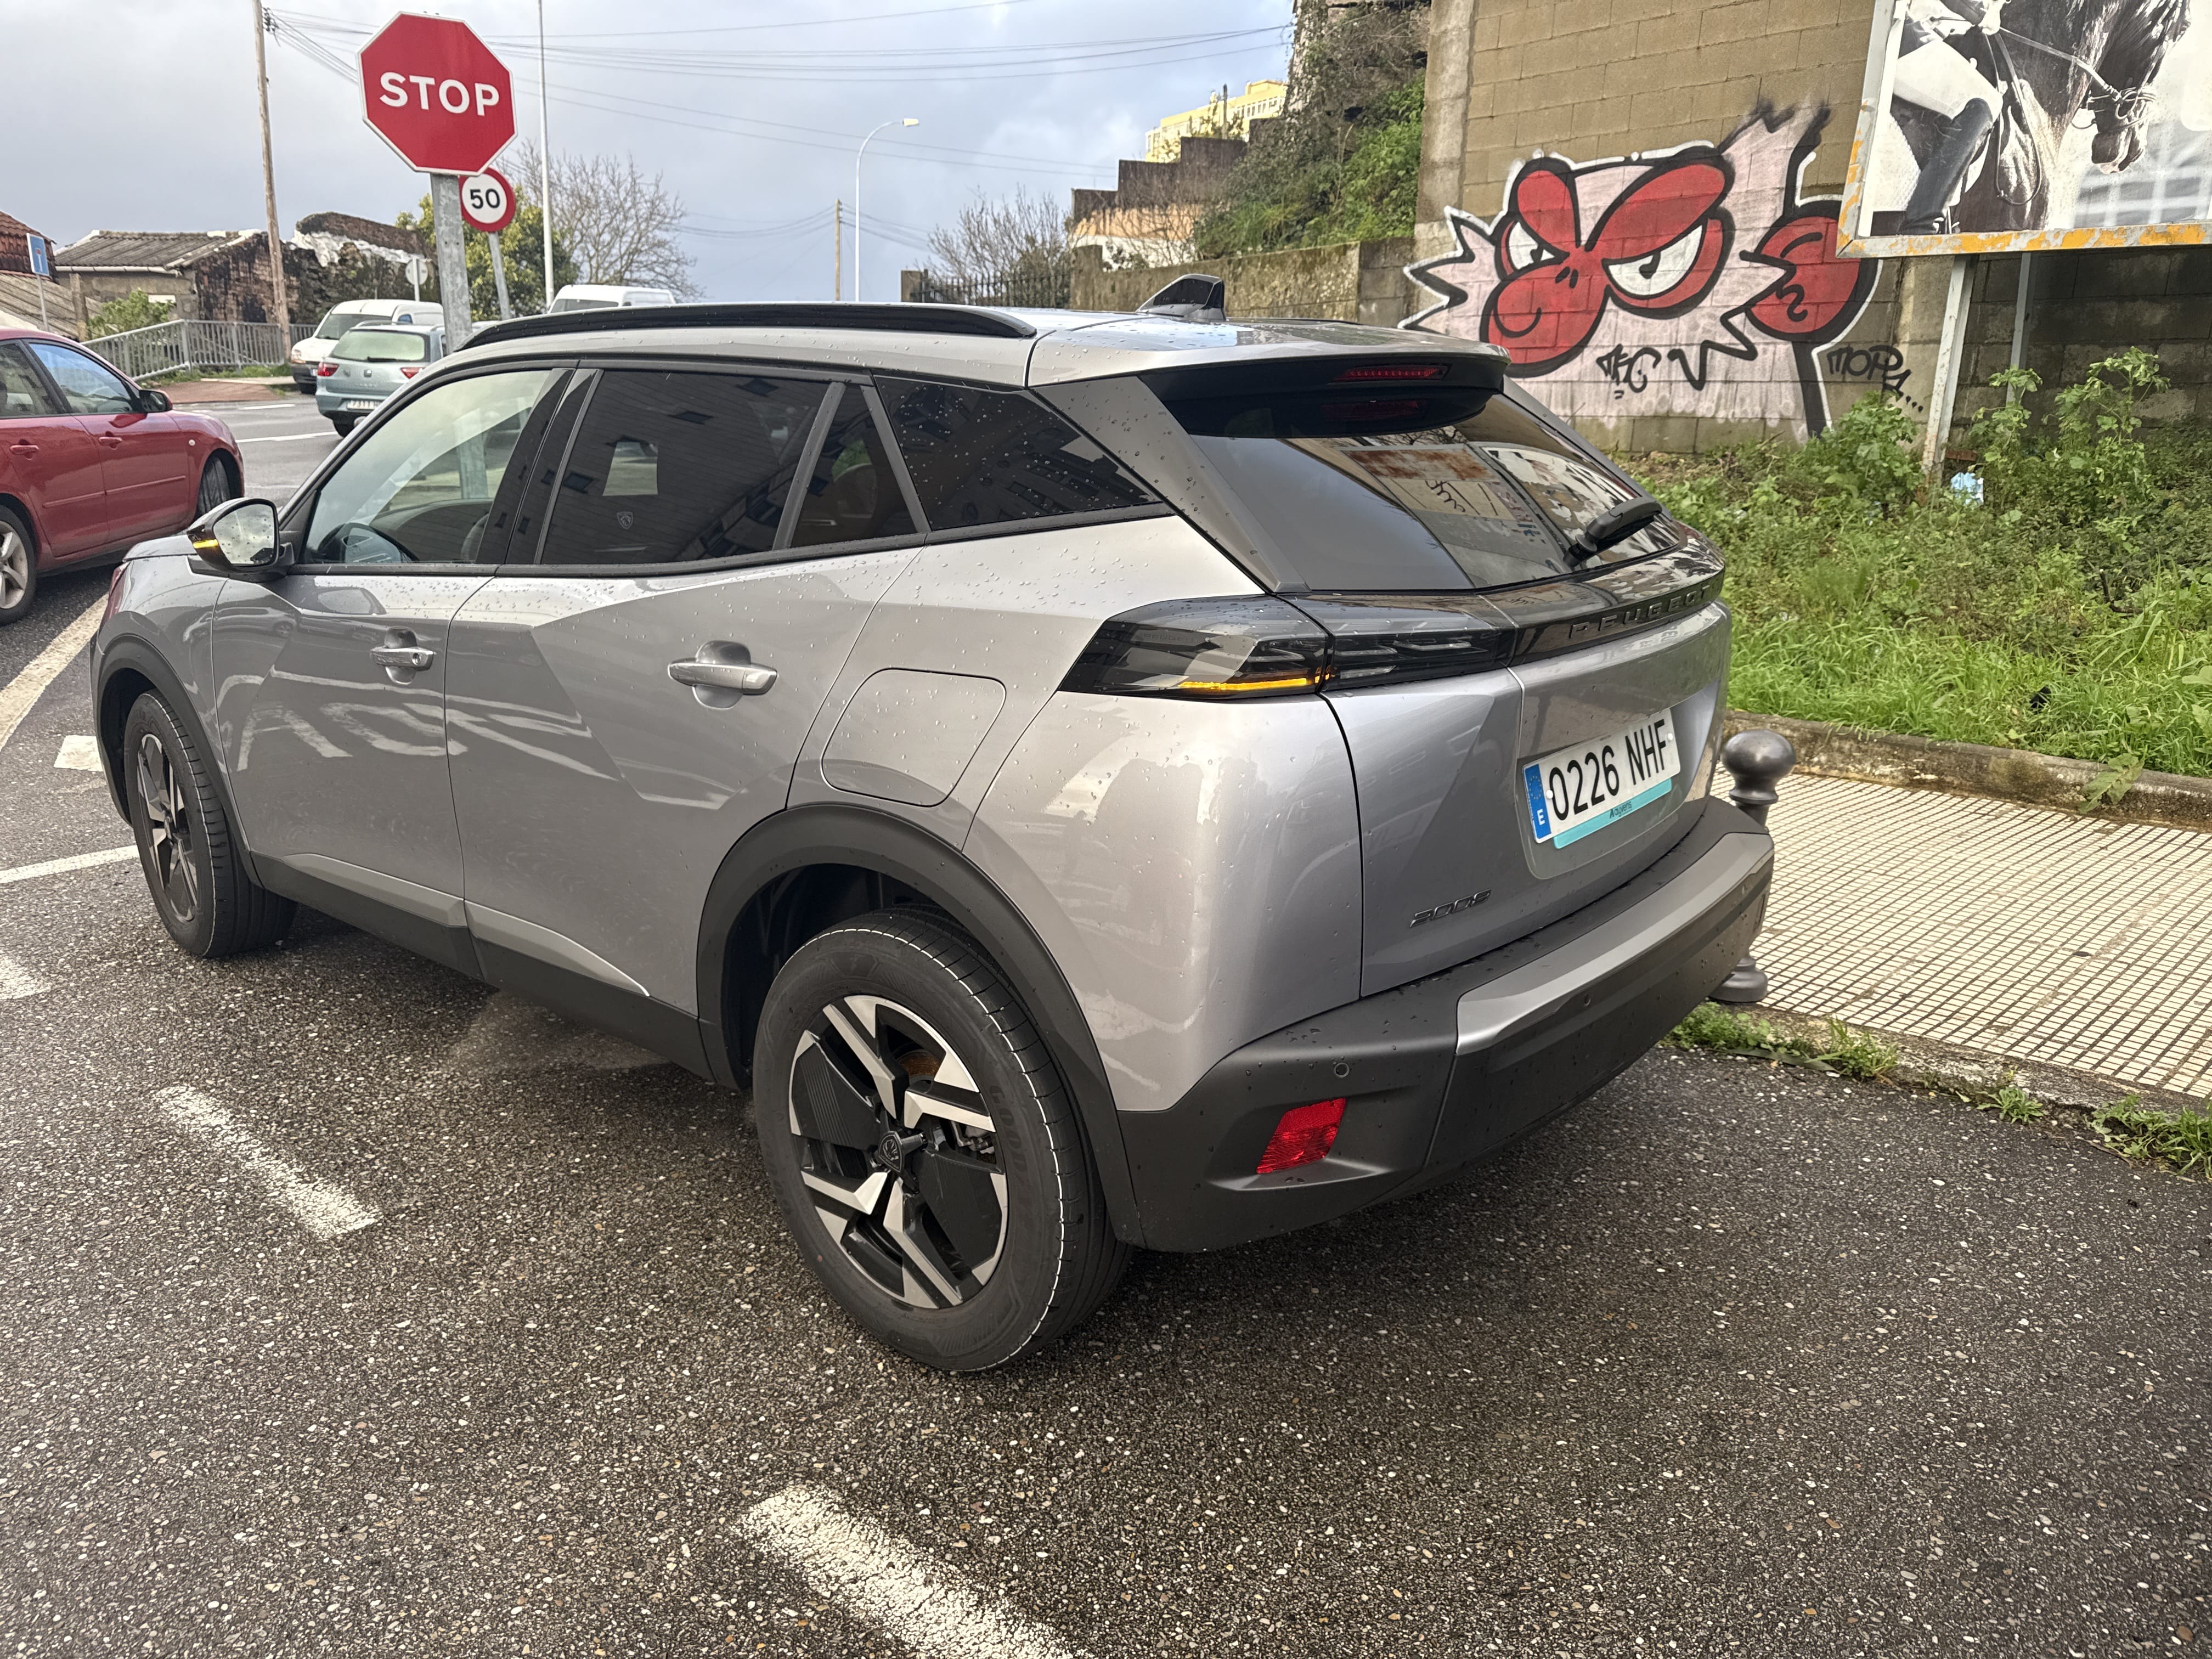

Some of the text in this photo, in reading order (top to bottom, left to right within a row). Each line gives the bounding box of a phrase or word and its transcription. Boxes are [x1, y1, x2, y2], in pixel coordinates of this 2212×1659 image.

[380, 72, 499, 116] STOP
[470, 188, 500, 210] 50
[1568, 584, 1711, 639] PEUGEOT
[1549, 744, 1620, 821] 0226
[1625, 718, 1667, 786] NHF
[1536, 808, 1546, 826] E
[1409, 888, 1492, 928] 2008
